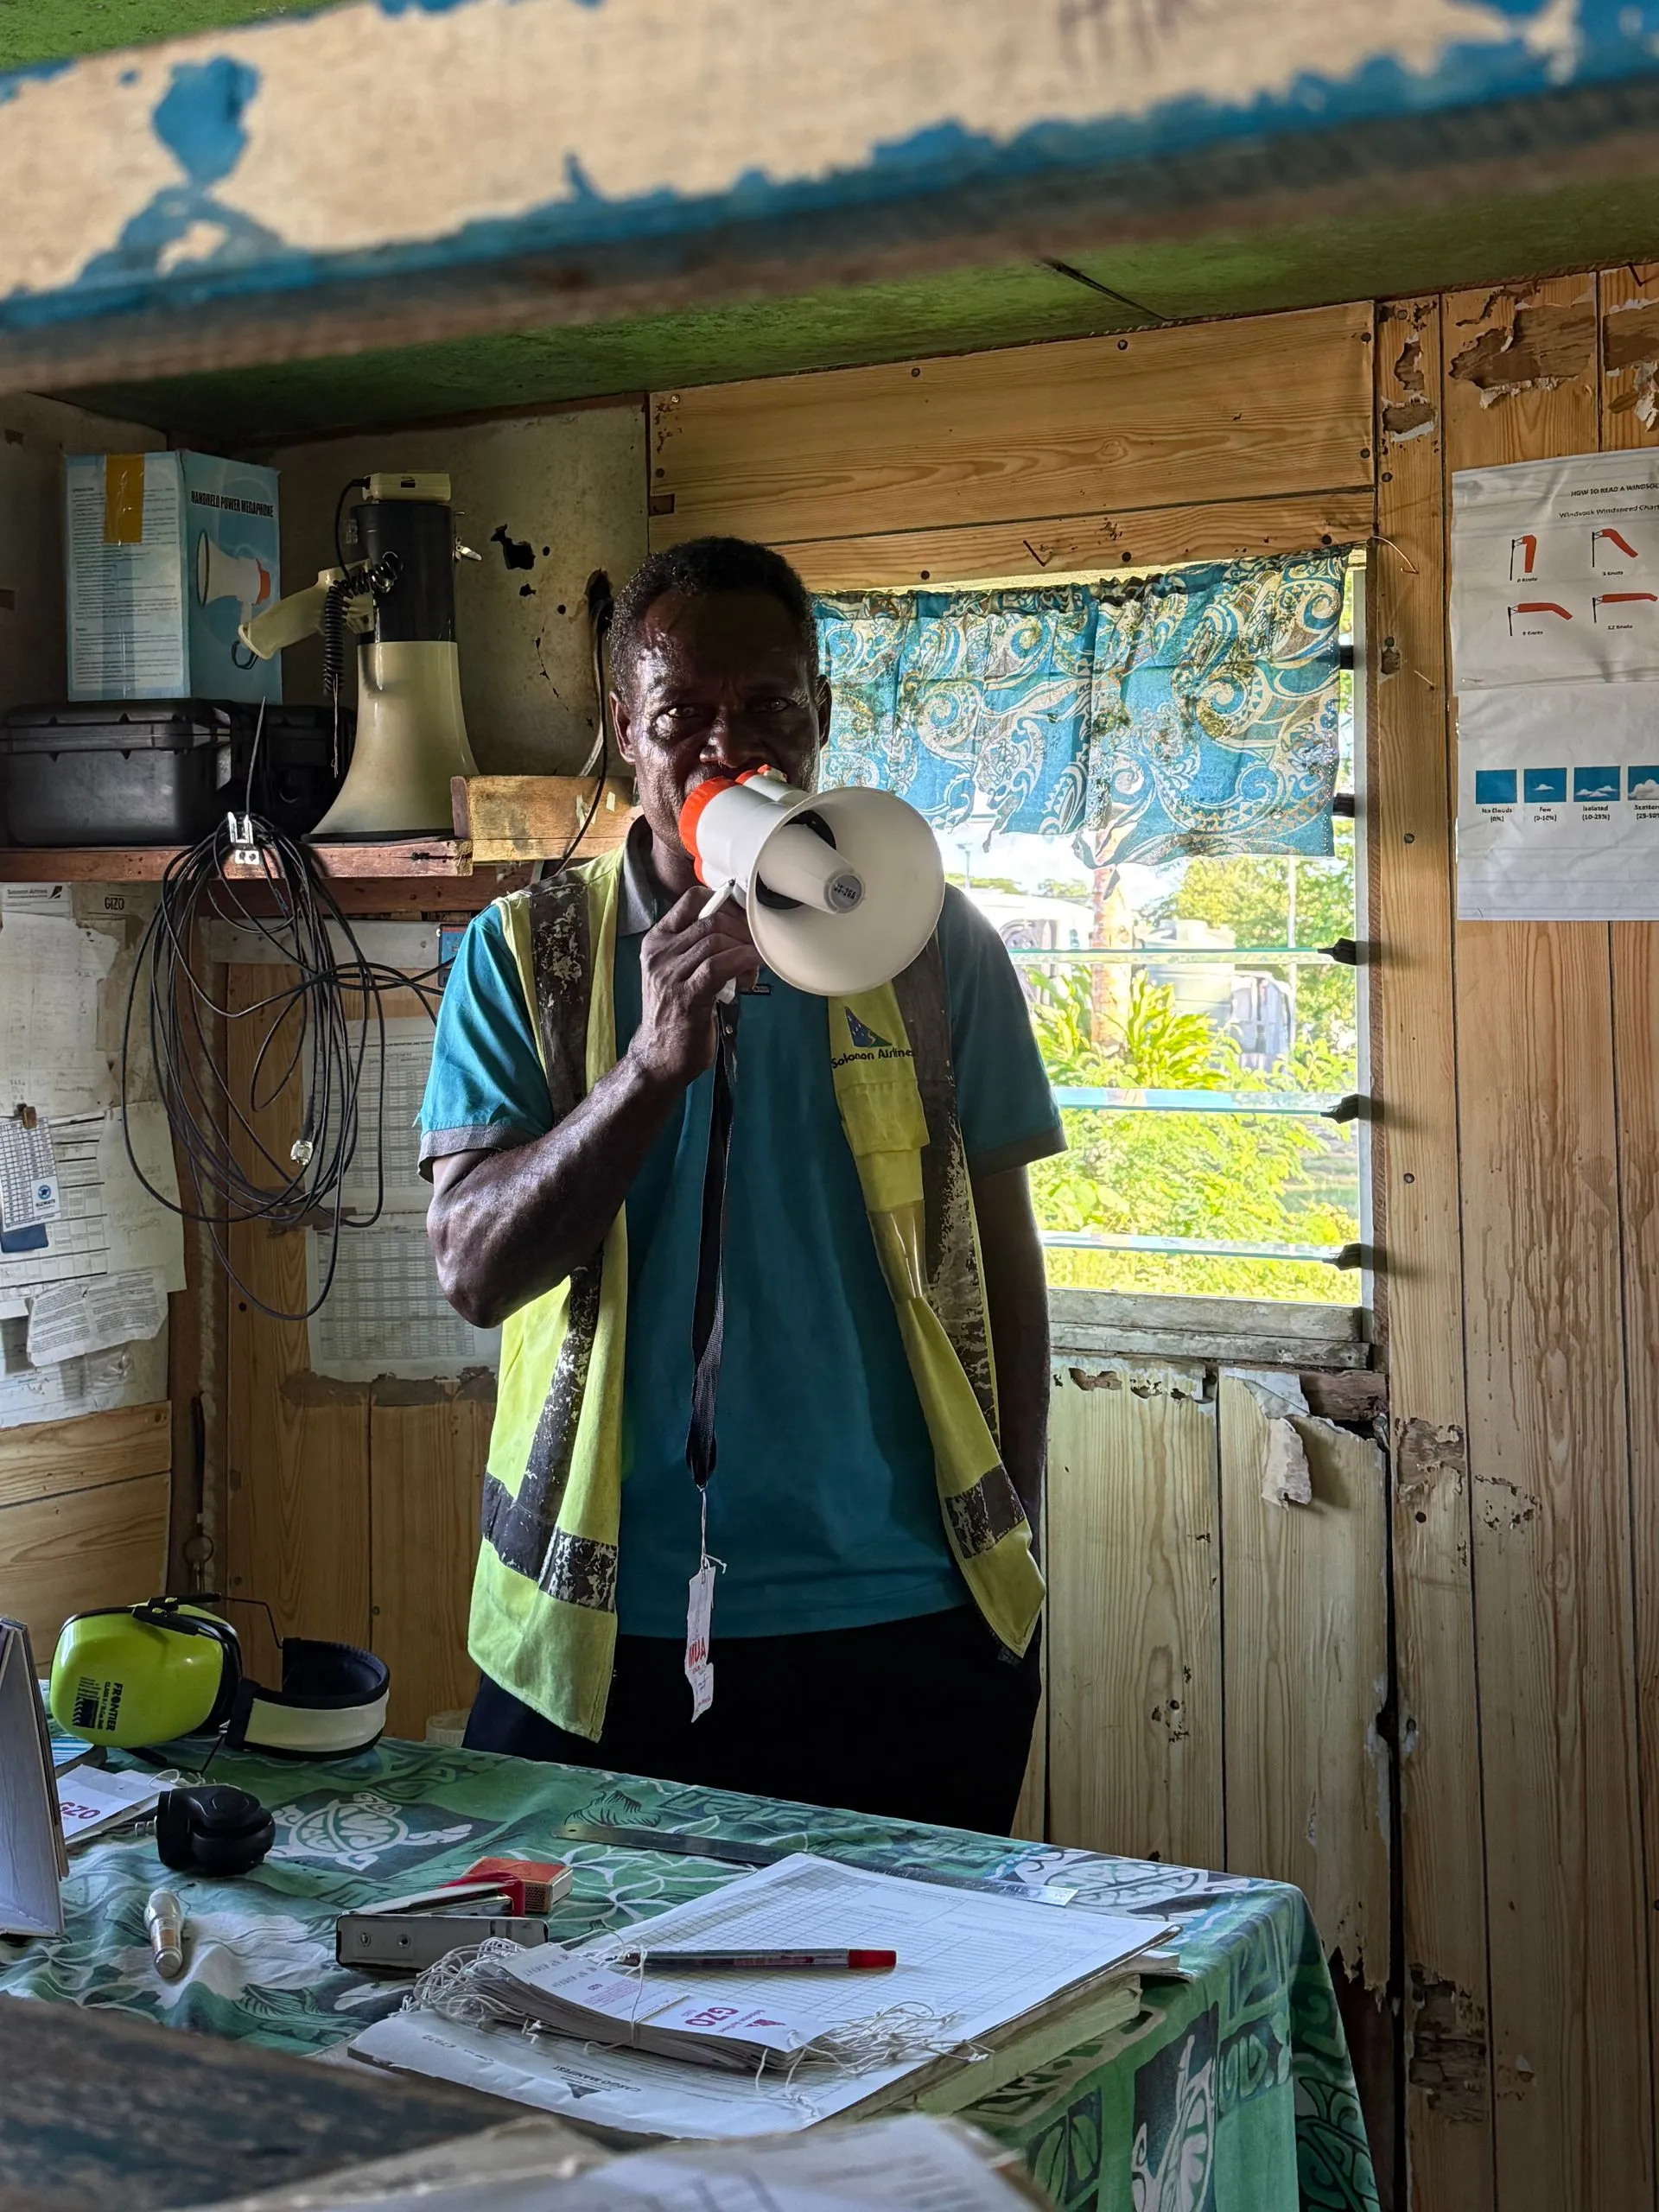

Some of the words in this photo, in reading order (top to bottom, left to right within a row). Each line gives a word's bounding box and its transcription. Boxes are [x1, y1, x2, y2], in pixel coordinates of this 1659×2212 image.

[1570, 489, 1589, 498] HOW
[191, 490, 219, 508] HANDHELD
[220, 496, 240, 512] POWER
[241, 499, 273, 518] MEGAPHONE
[1596, 505, 1638, 516] Windspeed
[104, 896, 125, 911] GIZO
[830, 1051, 875, 1070] Solomon
[105, 1681, 124, 1732] FRONTIER
[684, 2006, 740, 2027] GZO
[552, 2064, 602, 2082] MANIFEST
[601, 2079, 642, 2093] CARGO
